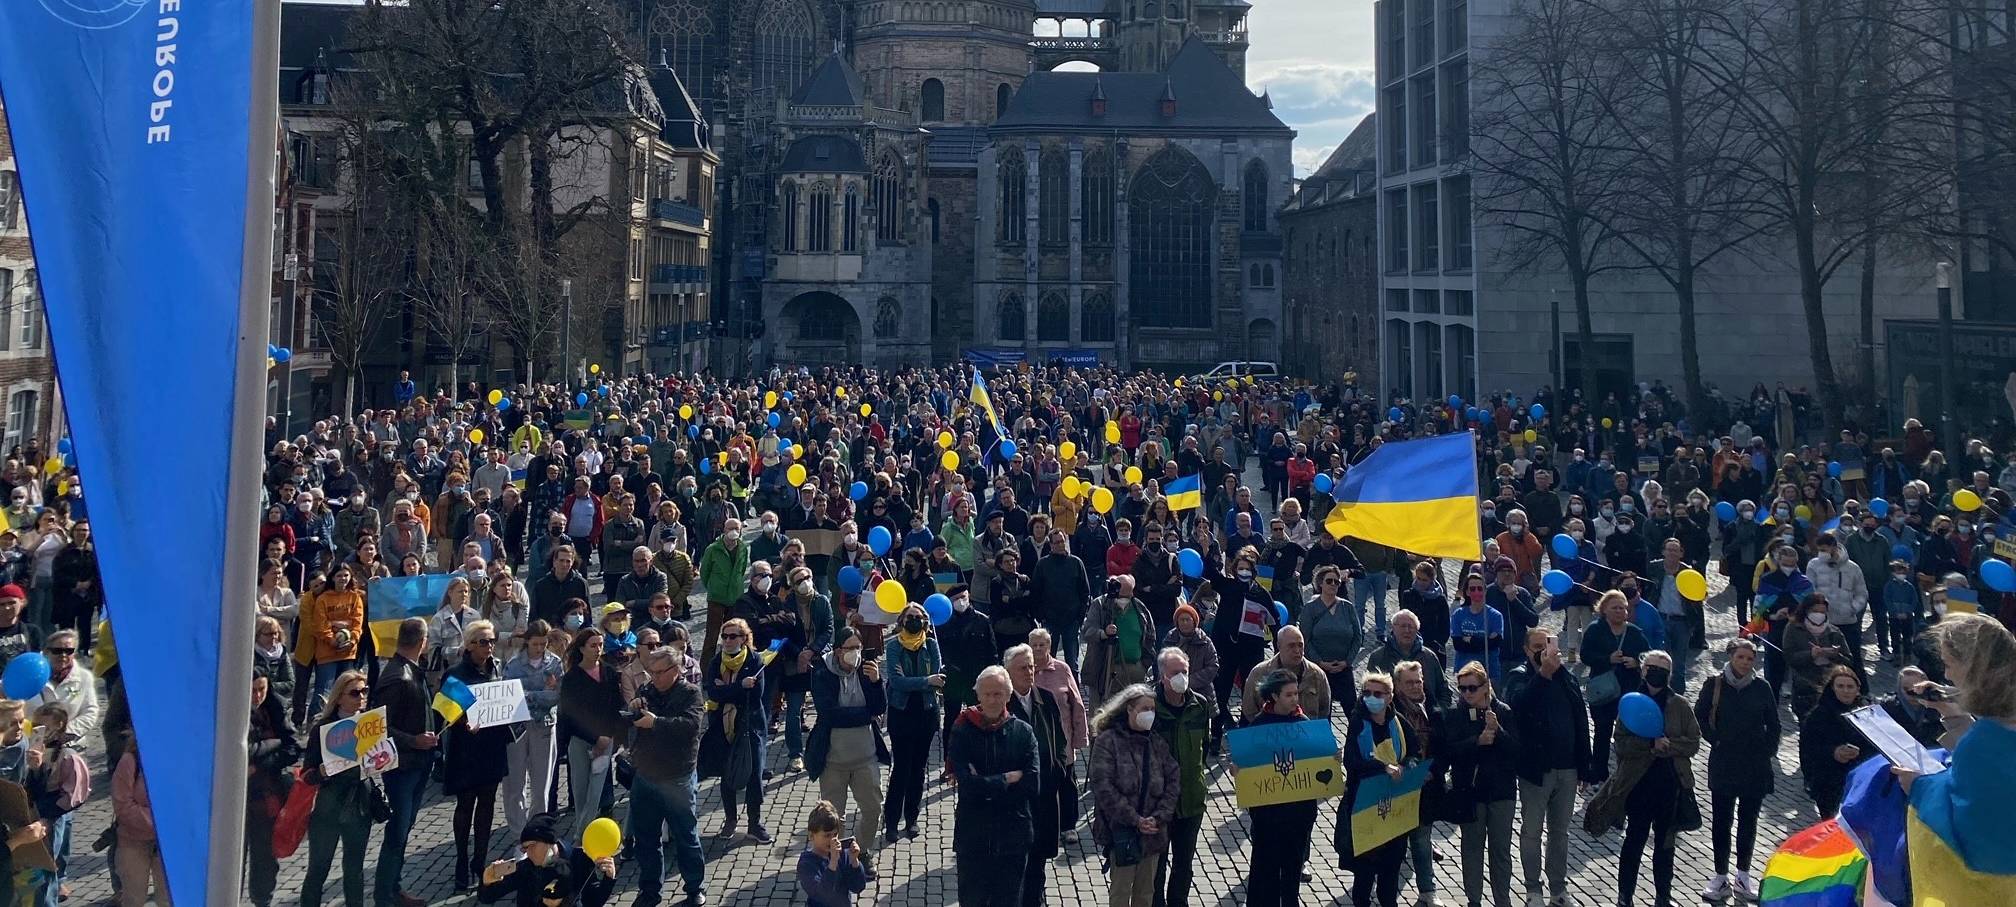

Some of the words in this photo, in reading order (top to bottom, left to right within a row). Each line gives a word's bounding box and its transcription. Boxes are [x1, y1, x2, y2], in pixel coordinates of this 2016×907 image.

[474, 682, 514, 700] PUTIN
[477, 704, 514, 725] KILLER
[357, 717, 387, 739] KRIEG
